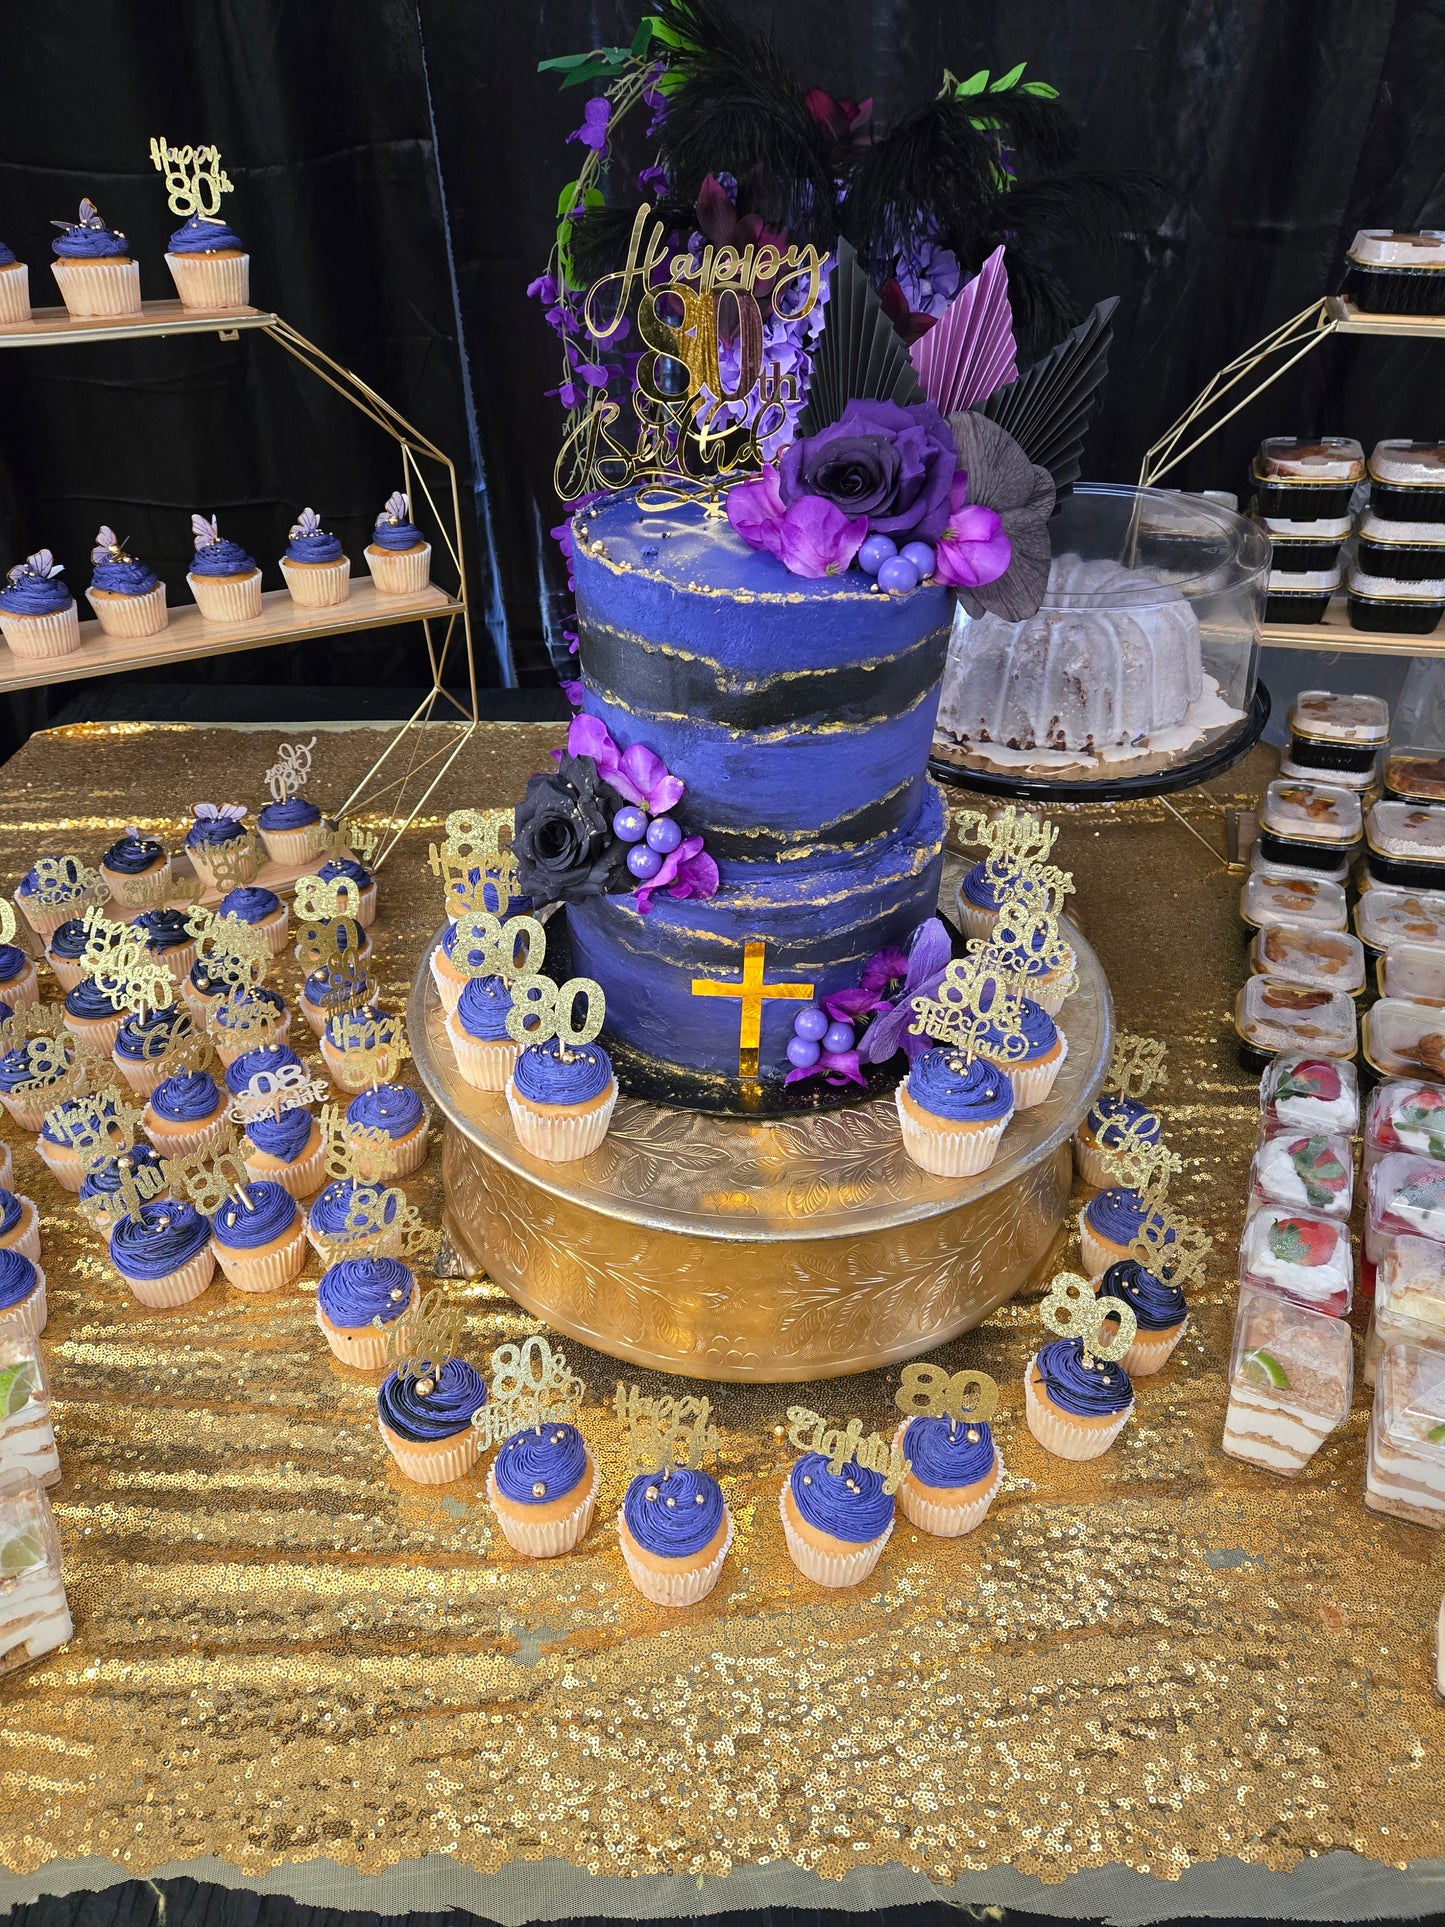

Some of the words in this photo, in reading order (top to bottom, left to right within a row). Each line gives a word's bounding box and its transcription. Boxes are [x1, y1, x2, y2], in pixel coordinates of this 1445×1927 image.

[149, 136, 221, 177] Happy
[584, 202, 830, 338] Happy
[635, 282, 801, 403] 80th
[427, 842, 512, 883] Happy
[955, 804, 1060, 863] Eighty
[81, 905, 152, 948] Happy
[293, 875, 361, 922] 80
[451, 911, 547, 981] 80
[991, 900, 1059, 958] 80
[505, 973, 606, 1046] 80
[938, 958, 1007, 1020] 80
[27, 1030, 79, 1079] 80
[330, 1013, 405, 1049] Happy
[907, 996, 1030, 1063] Fabulous
[44, 1084, 122, 1142] Happy
[317, 1103, 393, 1153] Happy
[344, 1186, 407, 1232] 80
[1039, 1271, 1138, 1362] 80
[491, 1335, 552, 1402] 80
[895, 1362, 1000, 1424] 80
[612, 1384, 714, 1434] Happy
[786, 1405, 913, 1494] Eighty
